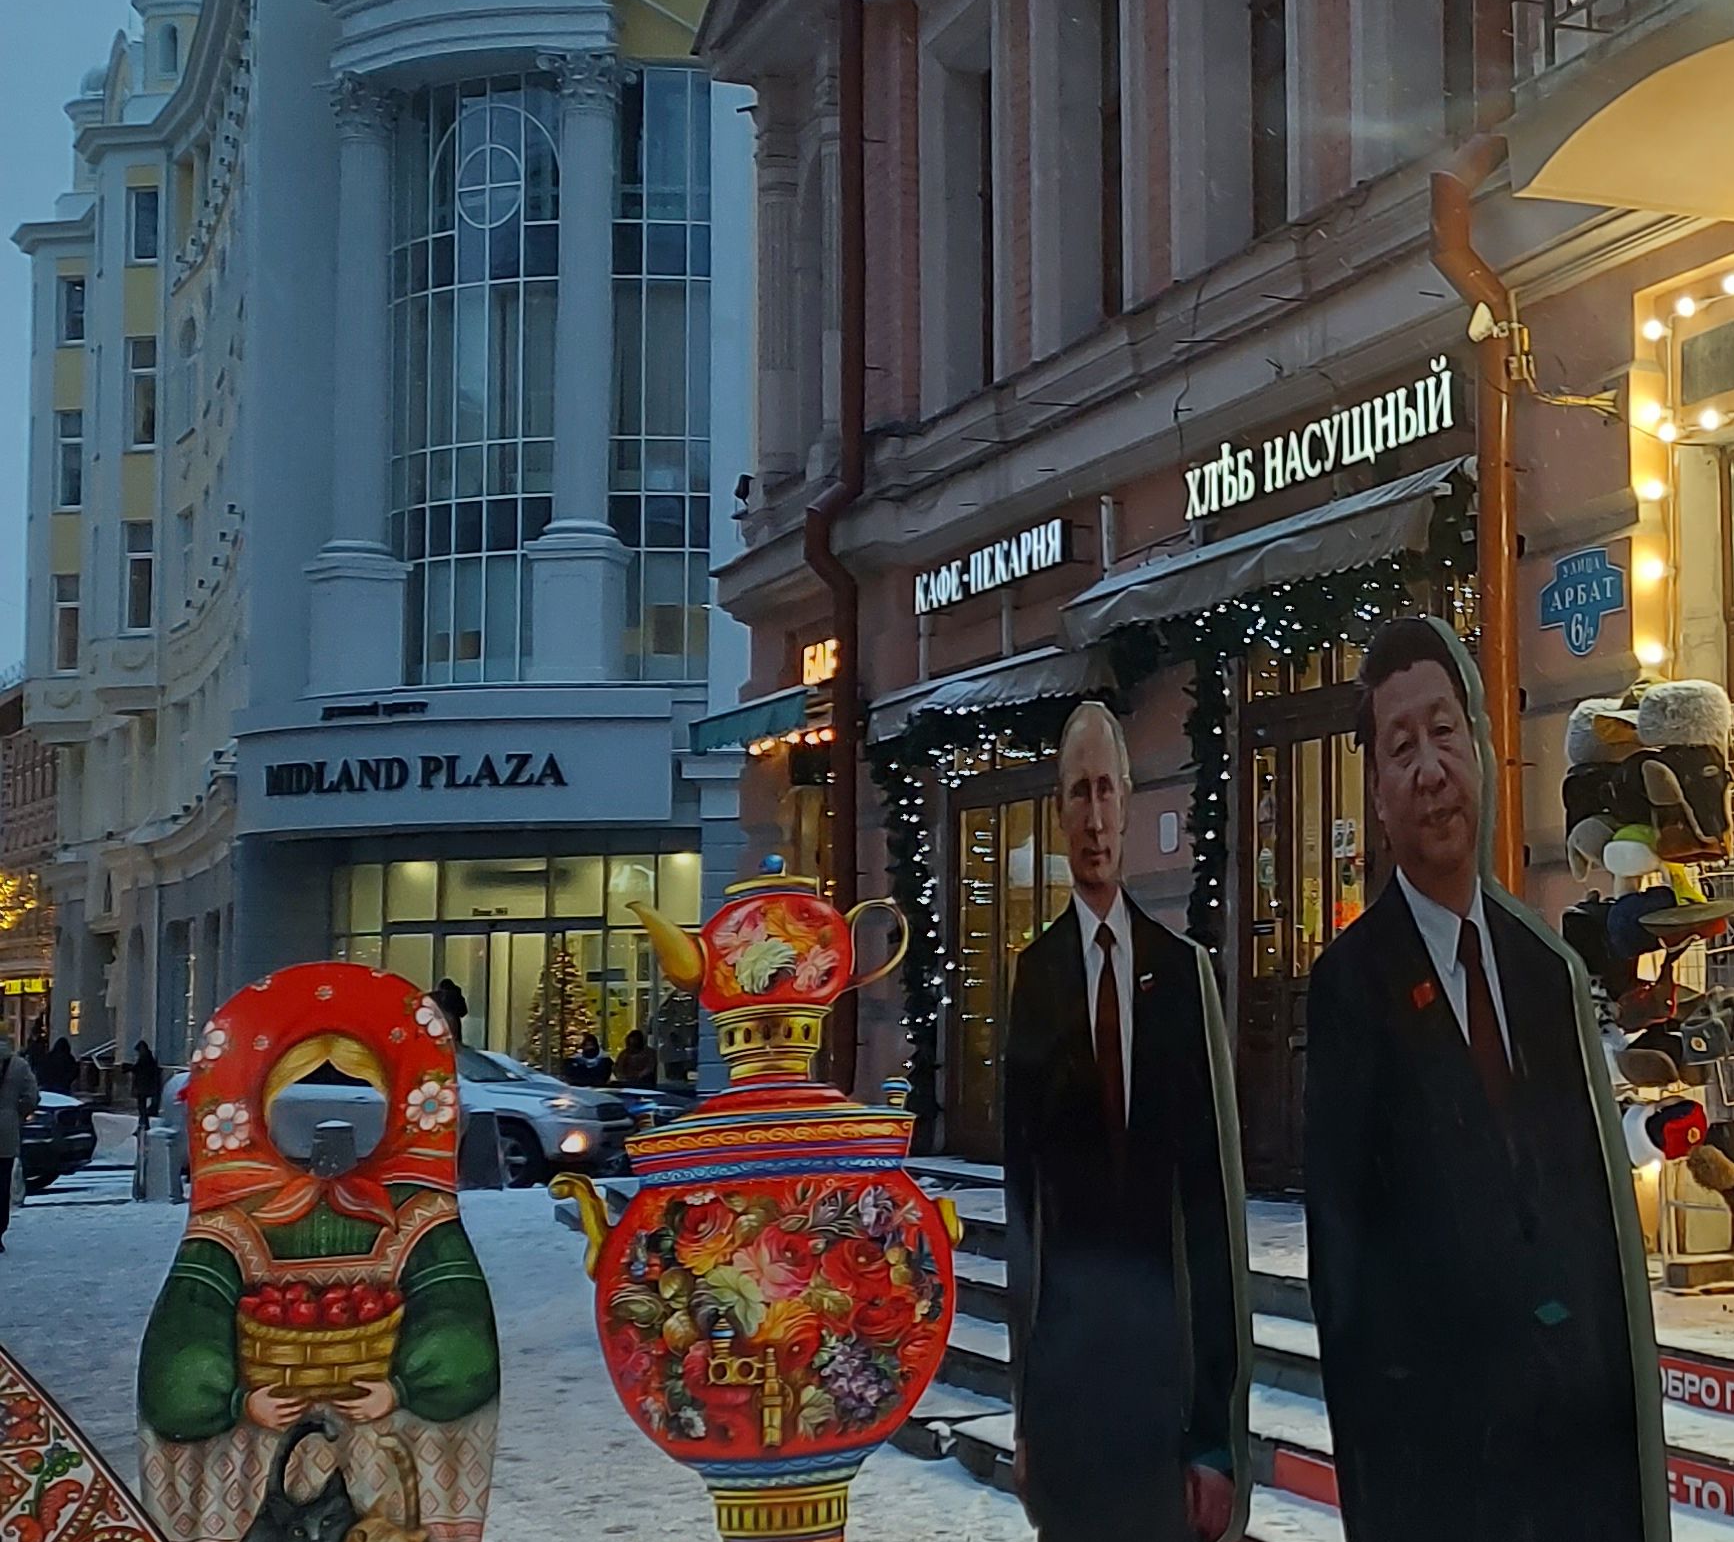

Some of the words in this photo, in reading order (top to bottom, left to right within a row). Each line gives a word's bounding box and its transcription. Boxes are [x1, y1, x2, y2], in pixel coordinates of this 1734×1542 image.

[1263, 354, 1454, 494] НАСУЩНЫЙ
[1562, 556, 1601, 579] УЛИЦА
[1549, 576, 1616, 613] АРБАТ
[1570, 612, 1597, 651] 6/2
[264, 756, 410, 796] MIDLAND
[417, 752, 569, 790] PLAZA
[1660, 1366, 1721, 1408] БРО
[1682, 1474, 1726, 1513] TO
